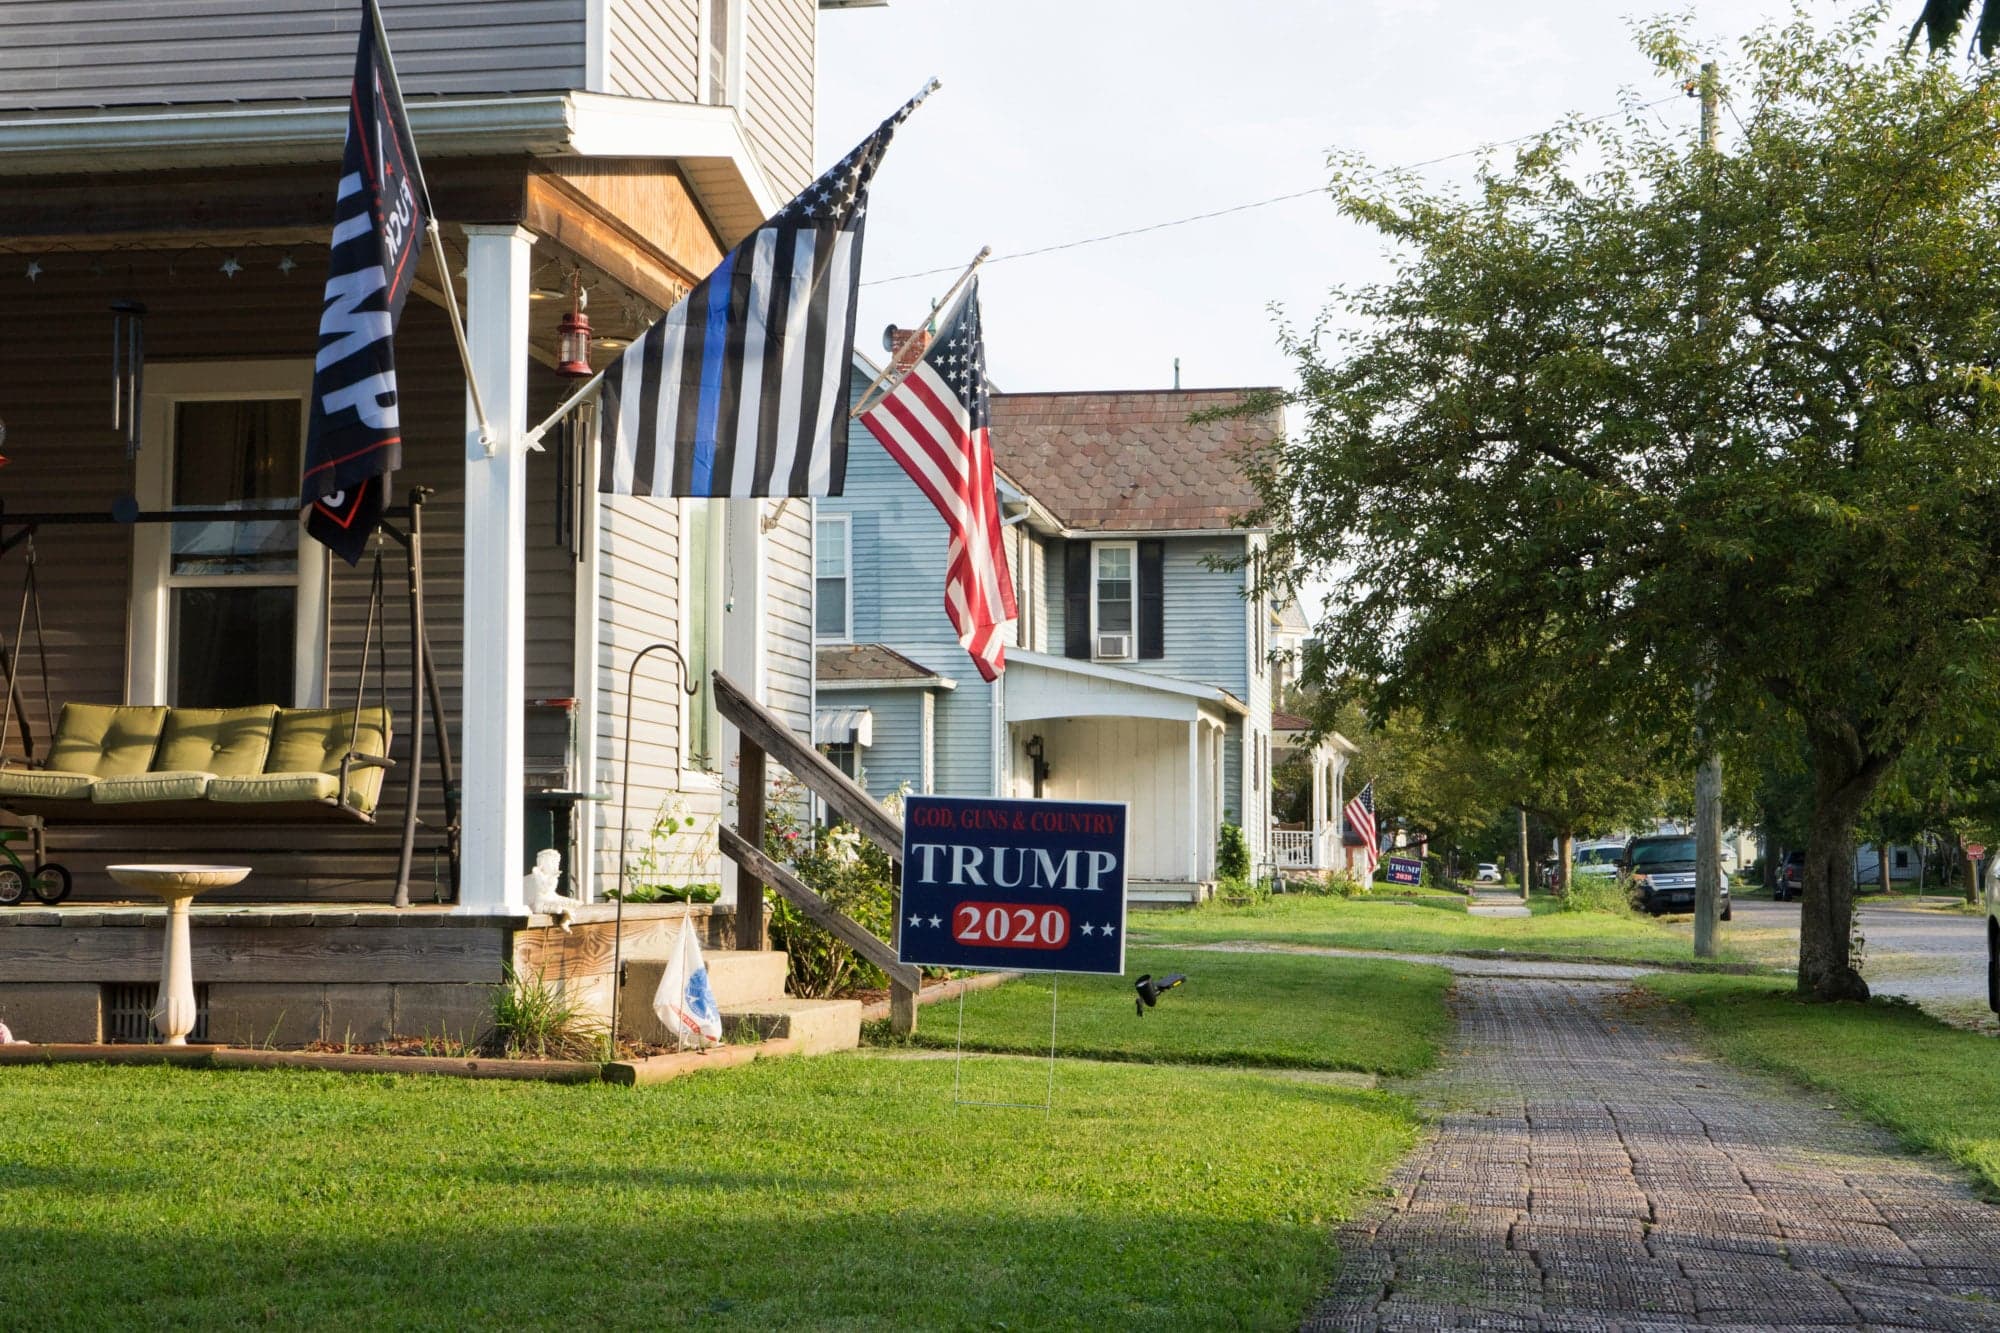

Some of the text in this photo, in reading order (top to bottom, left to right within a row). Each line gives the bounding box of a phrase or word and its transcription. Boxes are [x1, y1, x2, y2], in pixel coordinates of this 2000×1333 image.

[913, 807, 1119, 834] GOD, GUNS & COUNTRY
[911, 843, 1118, 891] TRUMP
[1391, 863, 1420, 874] TRUMP
[958, 906, 1065, 944] 2020
